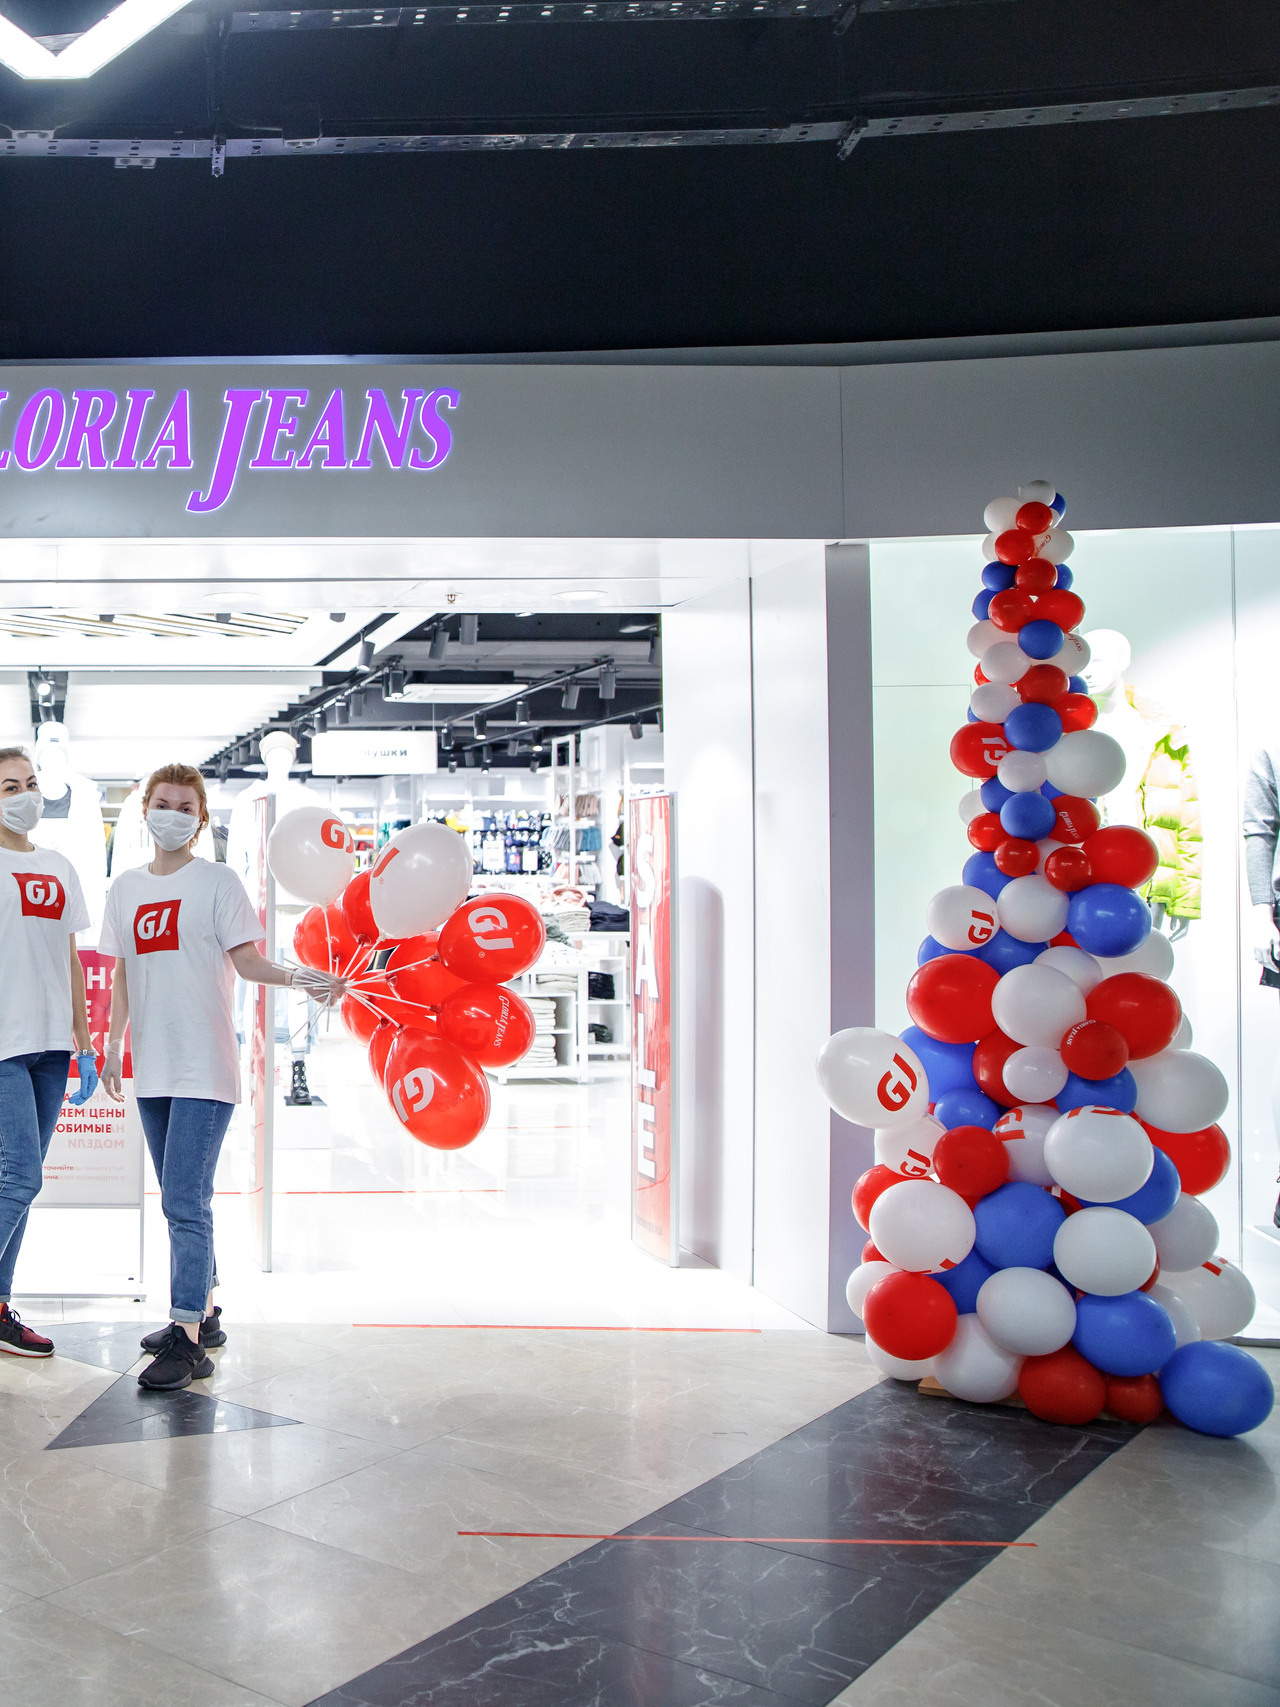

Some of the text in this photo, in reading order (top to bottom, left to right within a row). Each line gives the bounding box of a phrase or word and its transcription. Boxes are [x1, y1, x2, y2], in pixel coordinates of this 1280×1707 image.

[185, 387, 460, 514] JEANS
[25, 880, 59, 907] GJ
[136, 907, 172, 940] GJ
[467, 906, 515, 951] GJ
[967, 909, 995, 945] GJ
[493, 995, 510, 1048] GLORIA JEANS
[633, 832, 661, 1180] SALE
[1066, 1027, 1080, 1046] JEANS
[392, 1067, 435, 1124] GJ
[876, 1052, 918, 1112] GJ
[89, 1108, 125, 1119] ЦЕНЫ
[899, 1148, 932, 1177] GJ
